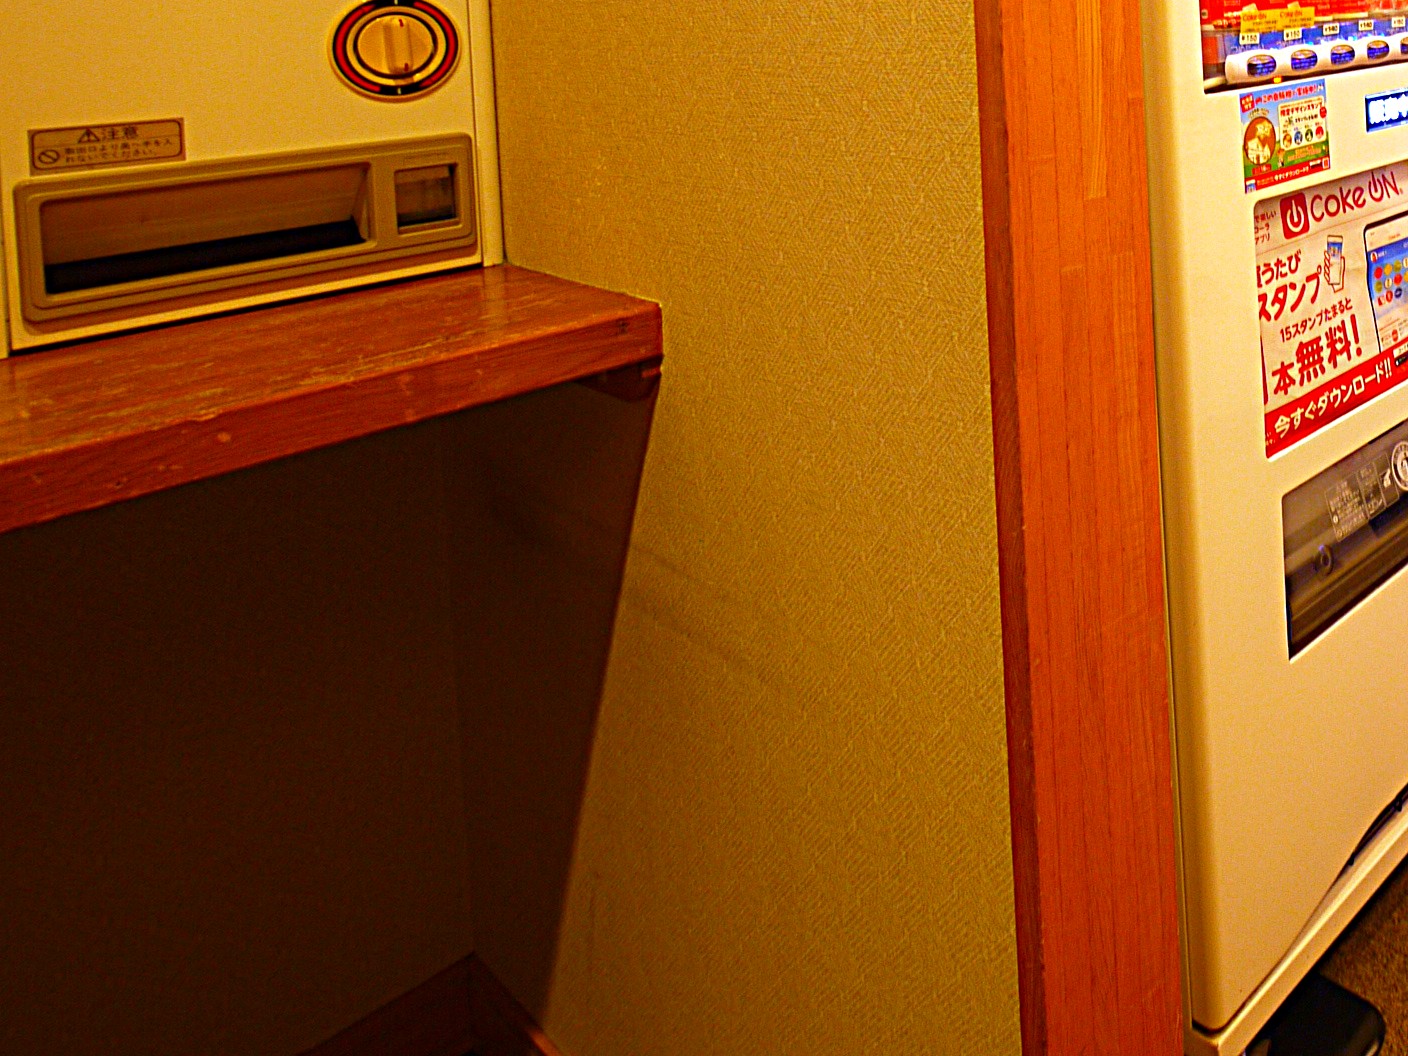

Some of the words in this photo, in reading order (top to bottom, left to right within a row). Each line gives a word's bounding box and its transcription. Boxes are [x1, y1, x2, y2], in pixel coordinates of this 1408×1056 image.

[1310, 188, 1365, 224] Coke
[1257, 266, 1324, 323] スタンプ
[1279, 296, 1354, 343] 15スタンプたまると
[1273, 359, 1393, 441] 今すぐダウンロード!!
